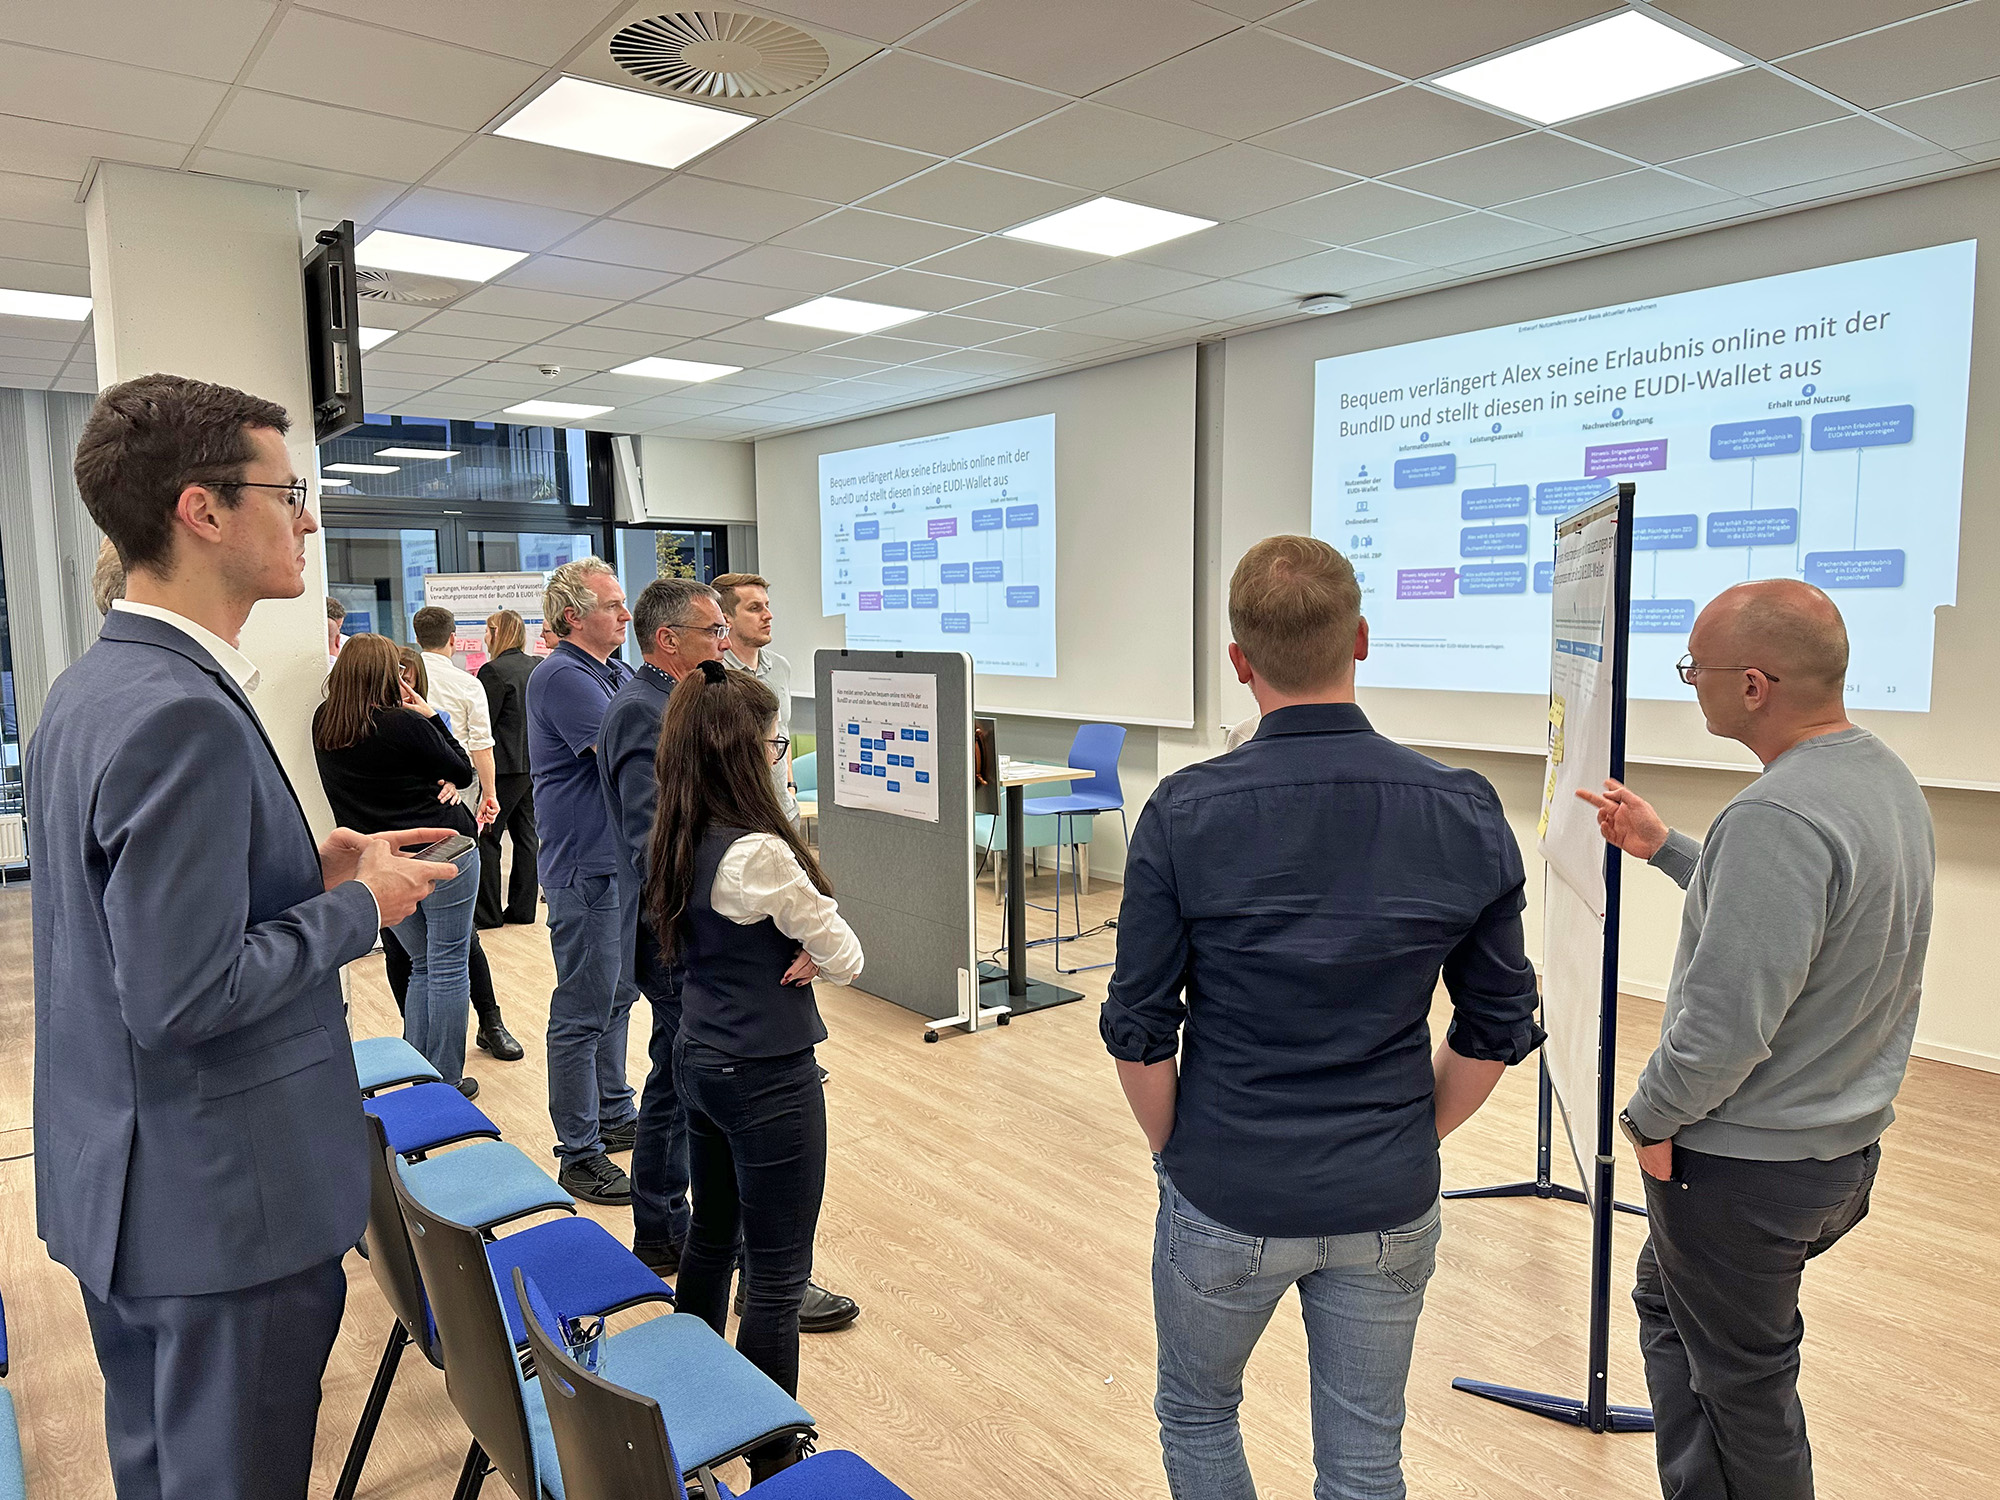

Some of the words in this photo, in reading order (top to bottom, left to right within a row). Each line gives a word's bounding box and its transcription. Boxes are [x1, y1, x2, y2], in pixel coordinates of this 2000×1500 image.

[1627, 303, 1657, 313] Annahmen
[1340, 387, 1403, 410] Bequem
[1409, 370, 1497, 399] verlängert
[1502, 365, 1541, 385] Alex
[1547, 356, 1598, 378] seine
[1605, 338, 1704, 369] Erlaubnis
[1712, 328, 1785, 354] online
[1795, 317, 1836, 342] mit
[1845, 310, 1890, 333] der
[1340, 413, 1394, 437] BundID
[1400, 408, 1431, 429] und
[1437, 401, 1478, 423] stellt
[1485, 395, 1544, 417] diesen
[1551, 391, 1567, 409] in
[1574, 384, 1626, 406] seine
[1634, 363, 1771, 398] EUDI-Wallet
[1780, 359, 1822, 380] aus
[1768, 400, 1792, 411] Erhalt
[1794, 397, 1811, 407] und
[1813, 394, 1850, 405] Nutzung
[1582, 415, 1653, 431] Nachweiserbringung
[1399, 440, 1451, 452] Informationssuche
[1470, 431, 1523, 444] Leistungsauswahl
[830, 477, 857, 489] Bequem
[858, 470, 892, 484] verlängert
[894, 467, 909, 479] Alex
[911, 464, 930, 477] seine
[932, 459, 968, 474] Erlaubnis
[970, 454, 995, 469] online
[998, 451, 1012, 464] mit
[1014, 449, 1029, 462] der
[830, 493, 854, 506] BundID
[856, 491, 868, 502] und
[870, 488, 886, 500] stellt
[889, 487, 911, 499] diesen
[913, 485, 920, 496] in
[922, 482, 941, 495] seine
[943, 475, 991, 492] EUDI-Wallet
[993, 475, 1008, 486] aus
